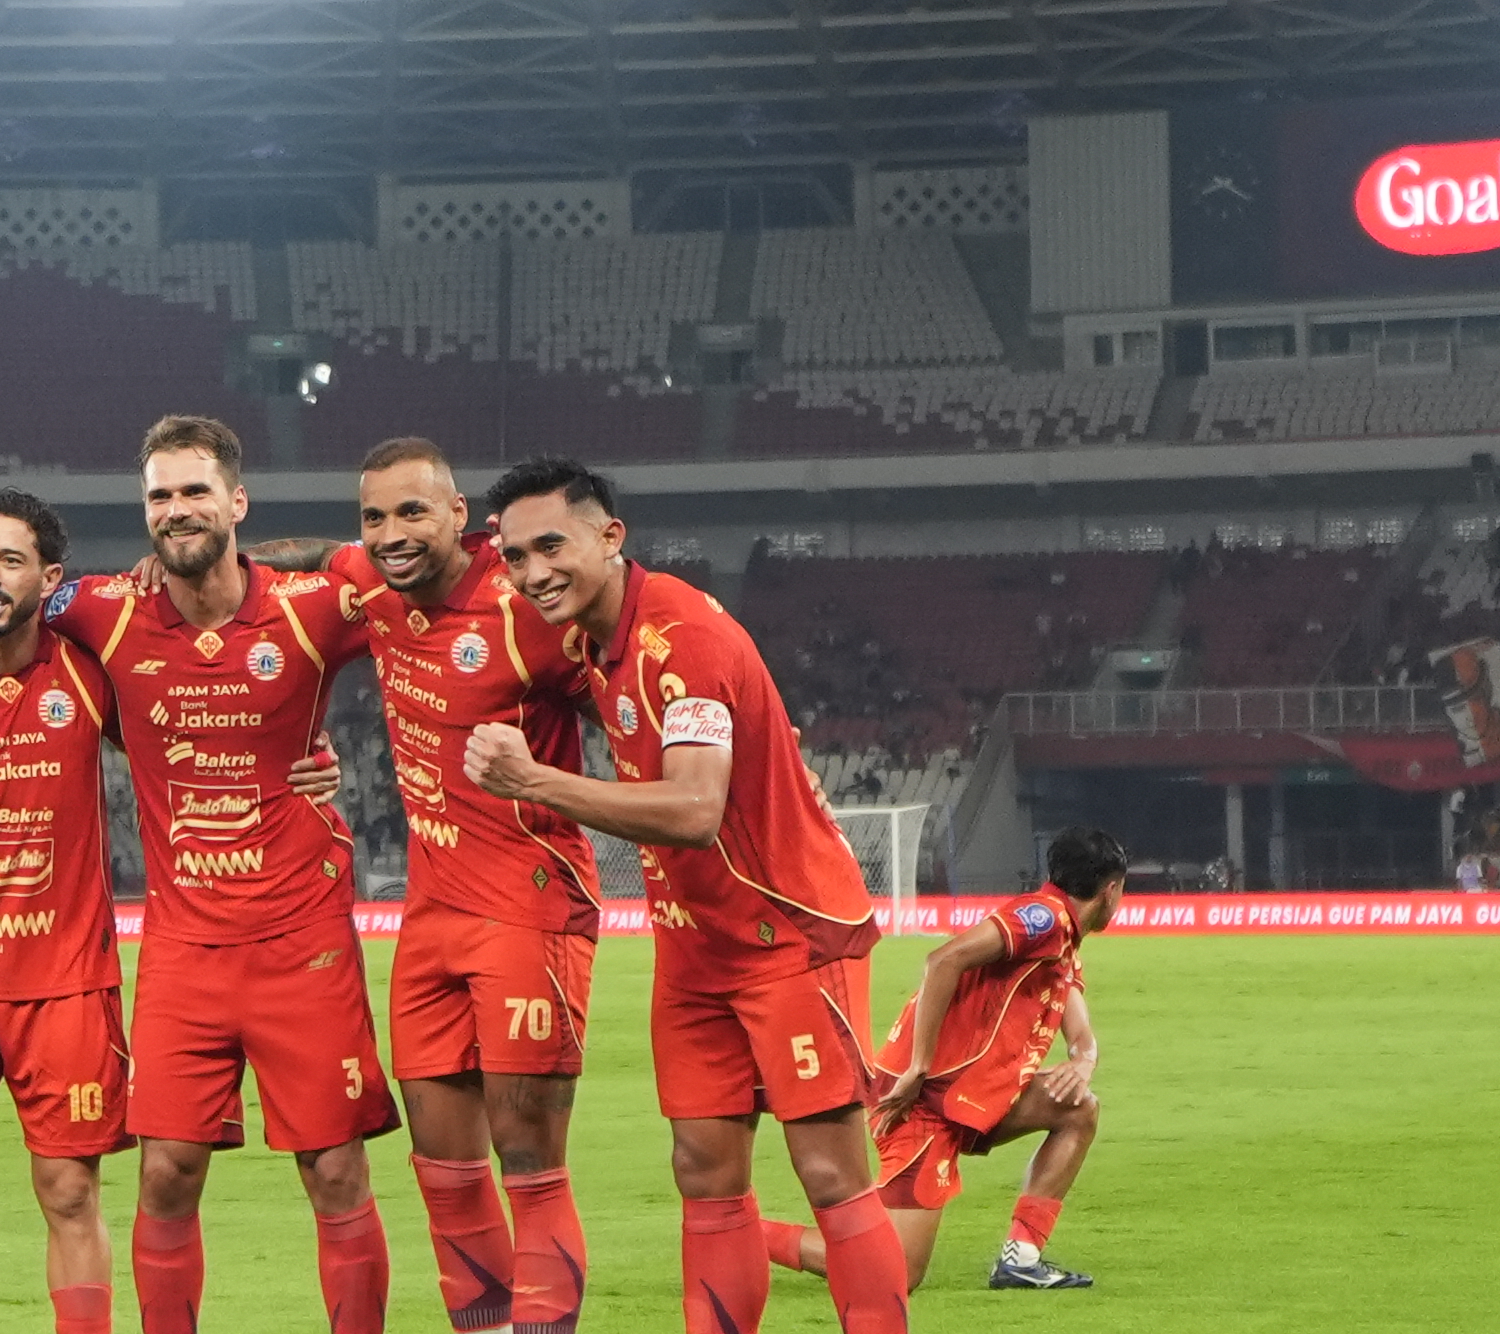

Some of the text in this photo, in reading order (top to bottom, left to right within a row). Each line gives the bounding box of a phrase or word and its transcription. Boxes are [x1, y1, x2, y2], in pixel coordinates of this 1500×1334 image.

[176, 683, 250, 697] PAM JAYA
[386, 672, 448, 714] Jakarta
[180, 700, 209, 710] Bank
[666, 700, 729, 724] COME ON
[175, 711, 262, 729] Jakarta
[12, 731, 46, 746] JAYA
[397, 715, 442, 748] Bakrie
[666, 722, 689, 739] YOU
[194, 751, 257, 768] Bakrie
[115, 916, 142, 932] GUE
[607, 909, 645, 928] PAM
[1150, 907, 1195, 925] JAYA
[1208, 905, 1462, 925] GUE PERSIJA GUE PAM JAYA
[504, 997, 552, 1042] 70
[791, 1033, 821, 1080] 5
[341, 1057, 364, 1101] 3
[68, 1082, 103, 1123] 10
